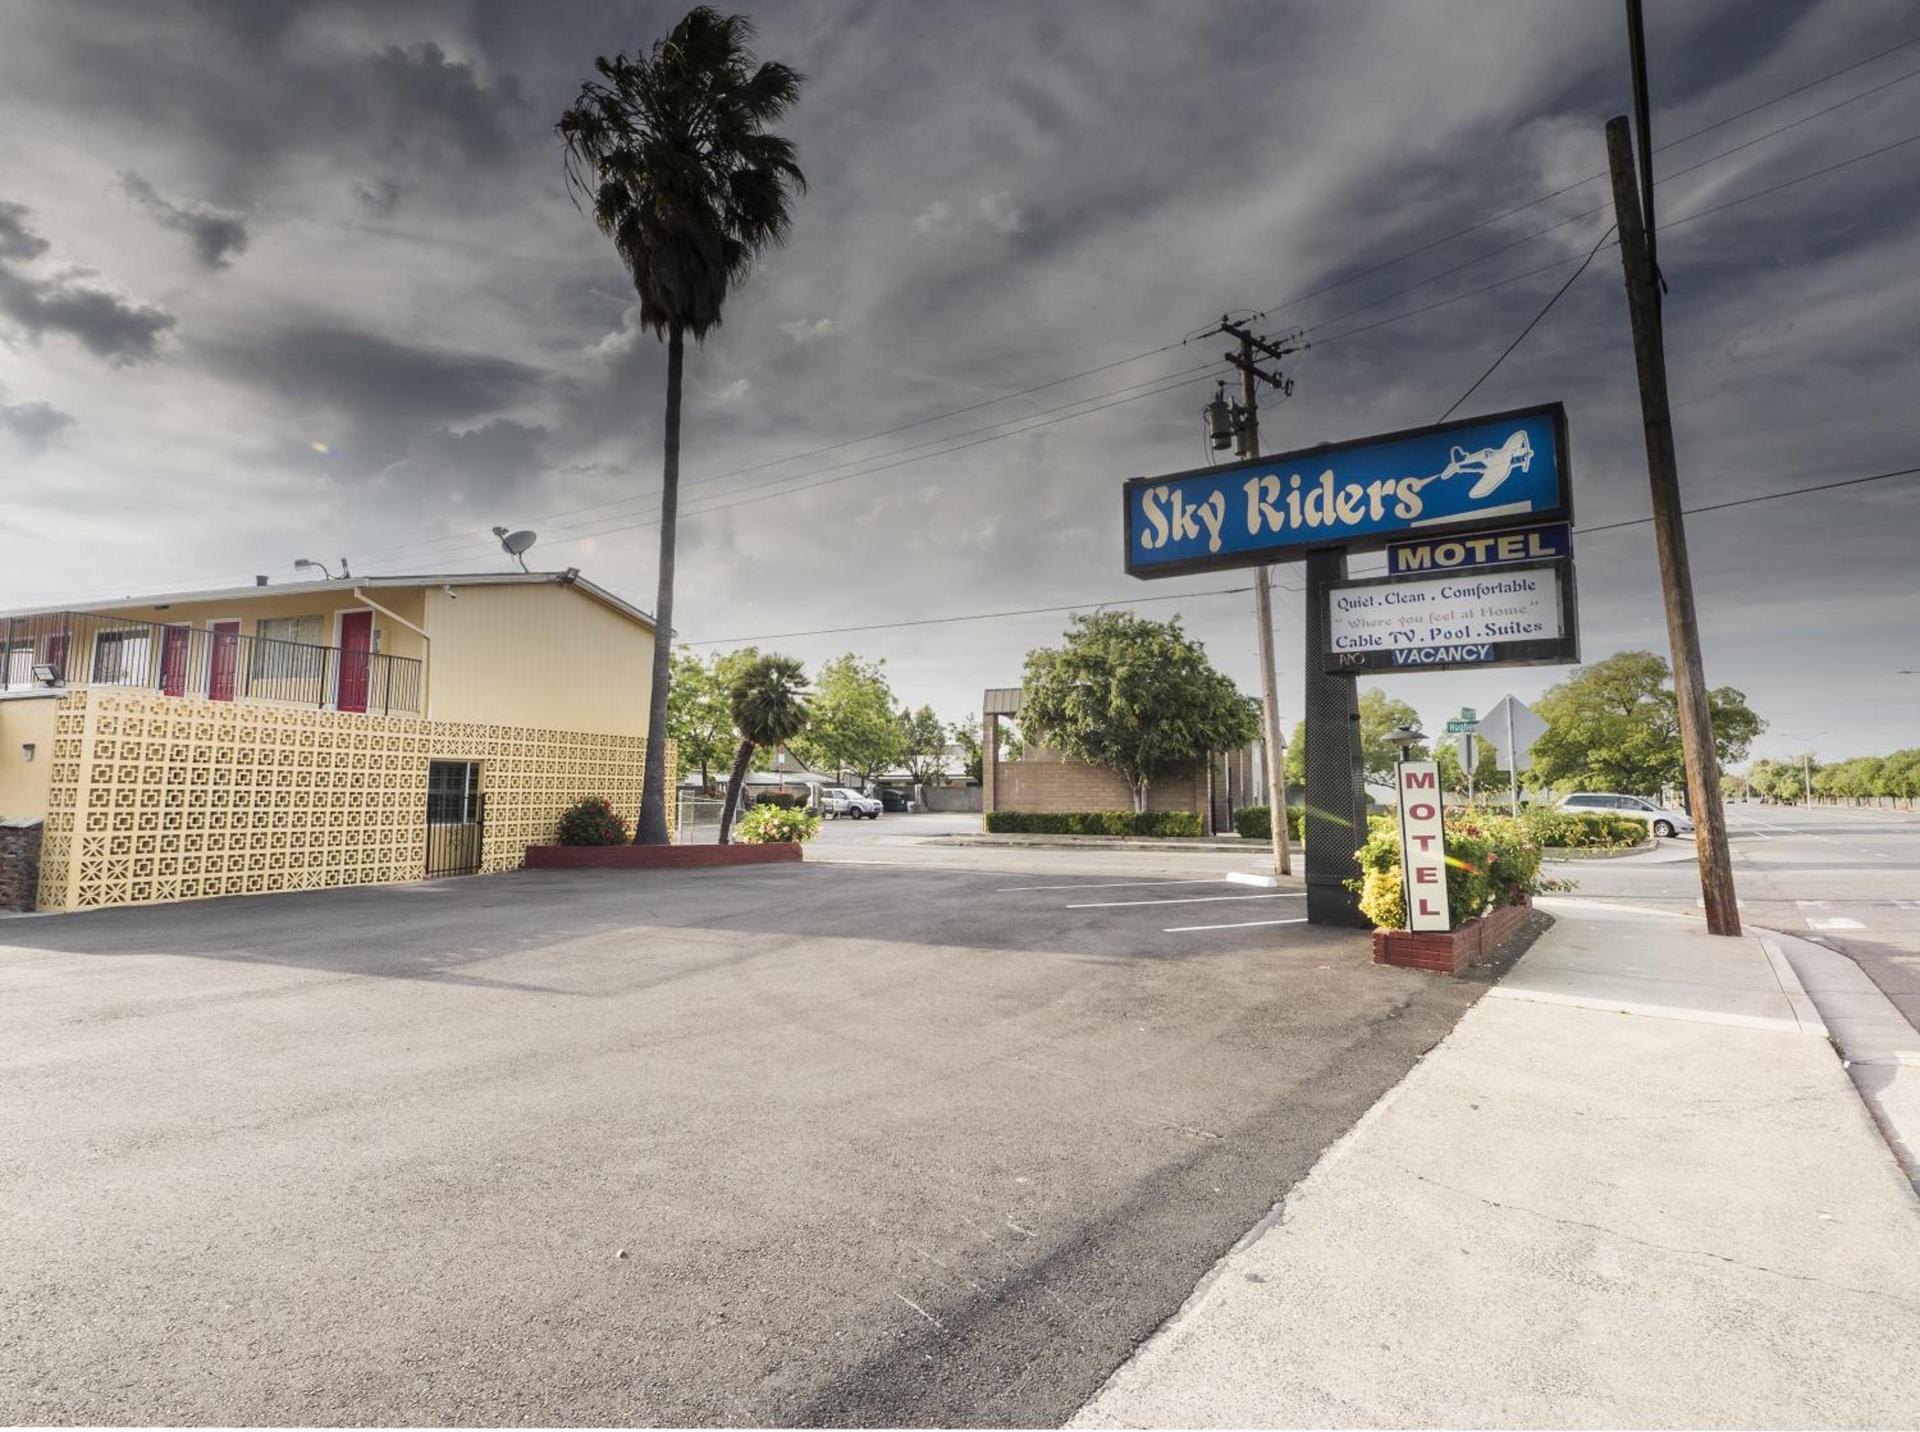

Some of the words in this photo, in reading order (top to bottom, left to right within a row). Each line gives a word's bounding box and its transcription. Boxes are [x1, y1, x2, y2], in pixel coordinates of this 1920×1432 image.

[1141, 486, 1226, 553] Sky
[1243, 468, 1426, 536] Riders
[1397, 532, 1556, 571] MOTEL
[1337, 596, 1375, 611] Quiet
[1384, 589, 1426, 606] Clean
[1440, 578, 1536, 601] Comfortable
[1399, 614, 1424, 626] you
[1429, 609, 1456, 624] feel
[1460, 606, 1474, 618] at
[1336, 631, 1383, 649] Cable
[1389, 629, 1416, 644] TV
[1430, 626, 1471, 640] Pool
[1485, 619, 1543, 637] Suites
[1394, 645, 1490, 664] VACANCY
[1405, 772, 1441, 916] MOTEL
